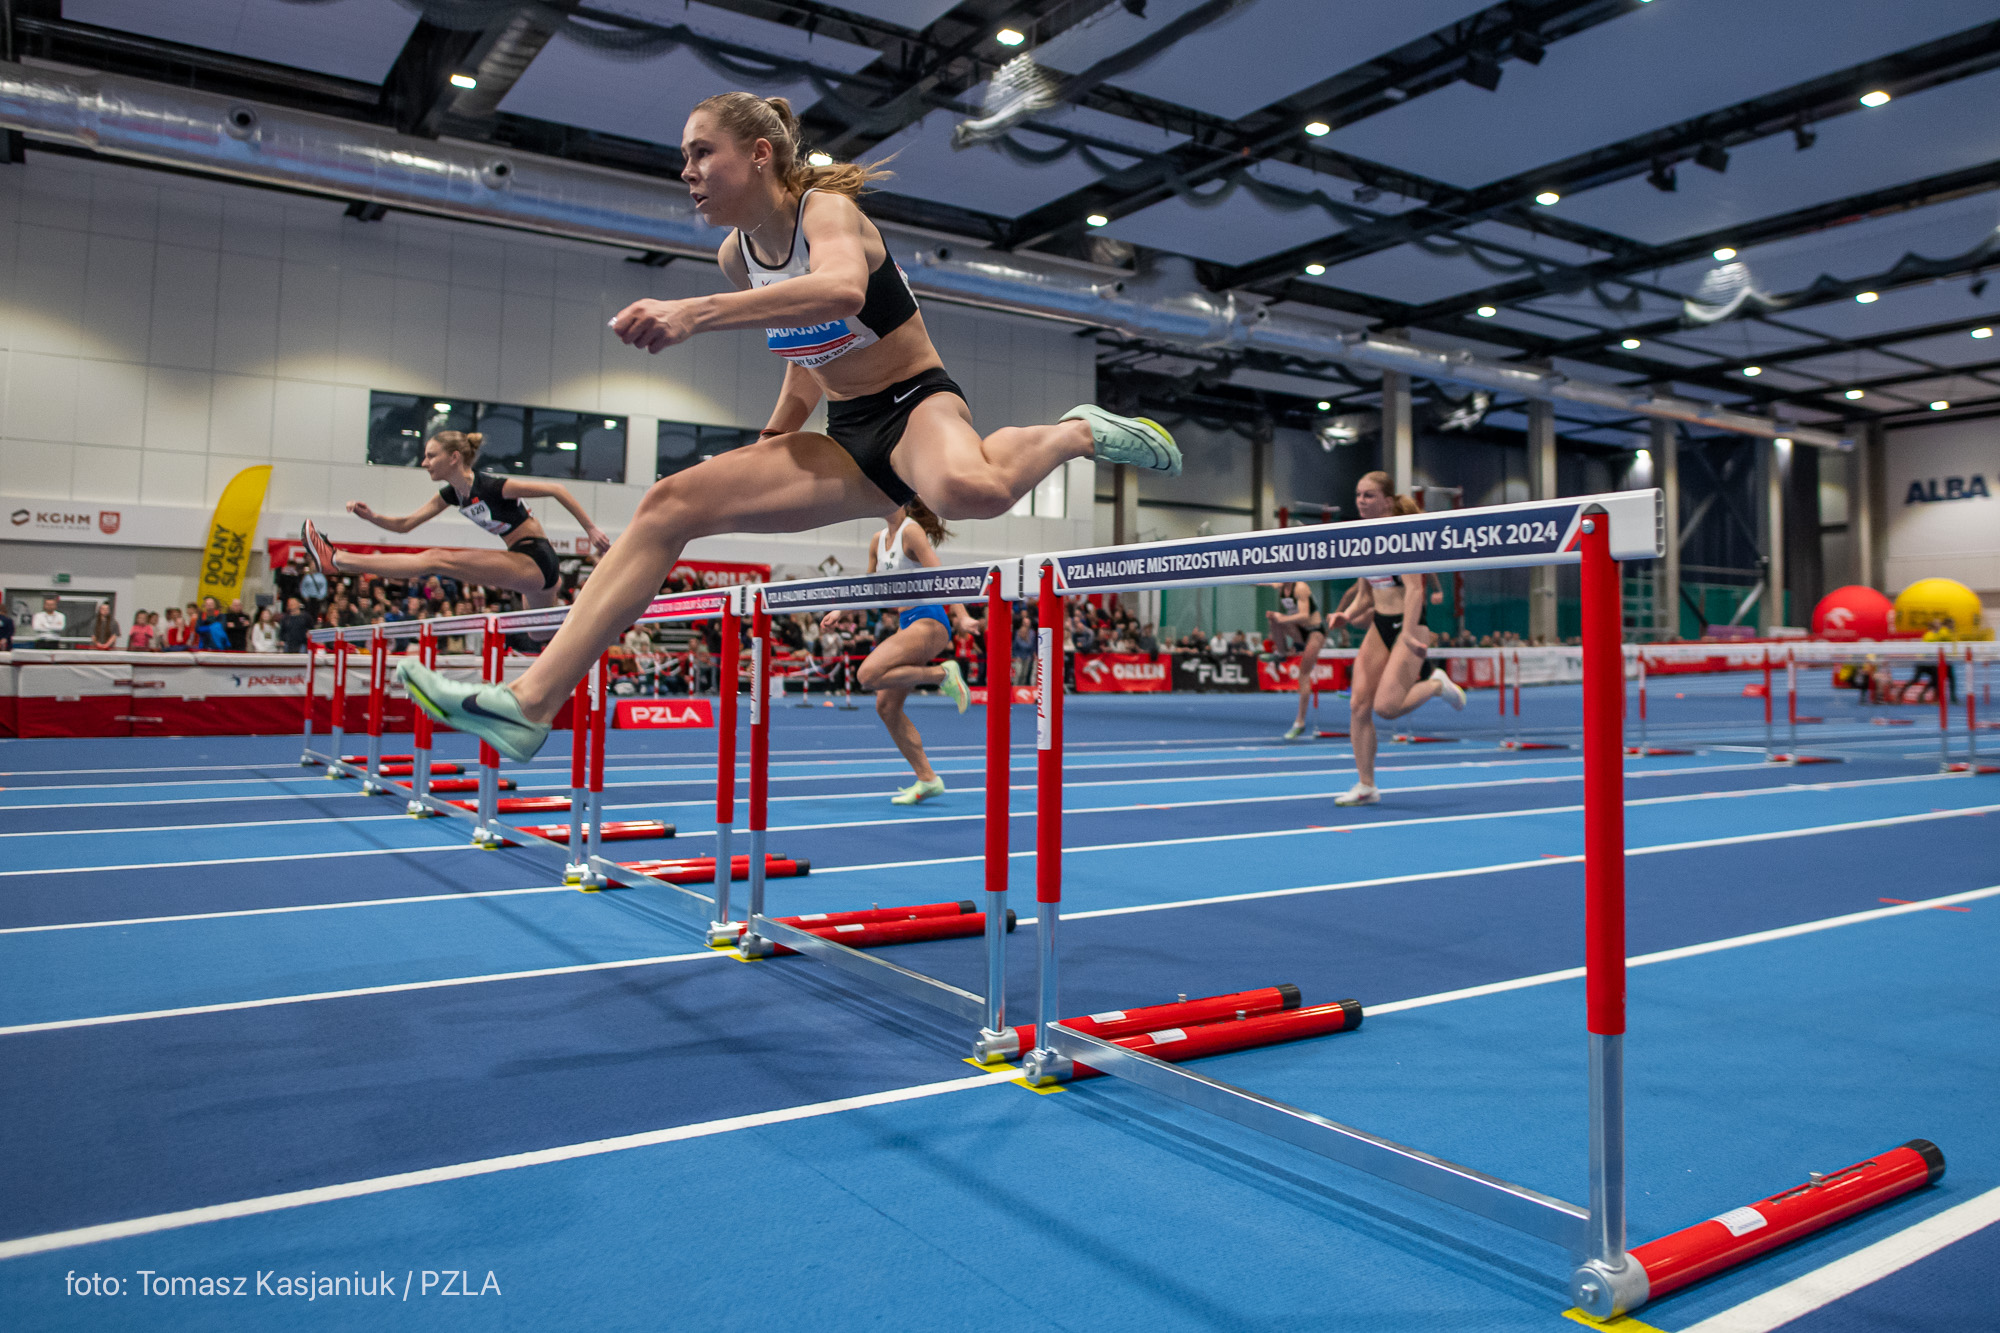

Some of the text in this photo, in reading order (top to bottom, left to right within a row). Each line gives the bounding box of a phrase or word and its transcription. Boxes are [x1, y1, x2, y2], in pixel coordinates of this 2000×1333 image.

[1905, 474, 1989, 505] ALBA
[36, 511, 91, 525] KGHM
[205, 524, 229, 585] DOLNY
[1067, 520, 1558, 580] PZLA HALOWE MISTRZOSTWA POLSKI U18 i U20 DOLNY ŚLĄSK 2024
[850, 583, 874, 597] POLSKI
[907, 579, 934, 593] DOLNY
[934, 576, 960, 594] ŚLĄSK
[960, 575, 981, 590] 2024
[1112, 662, 1165, 680] ORLEN
[1199, 664, 1249, 684] FUEL
[630, 706, 702, 724] PZLA
